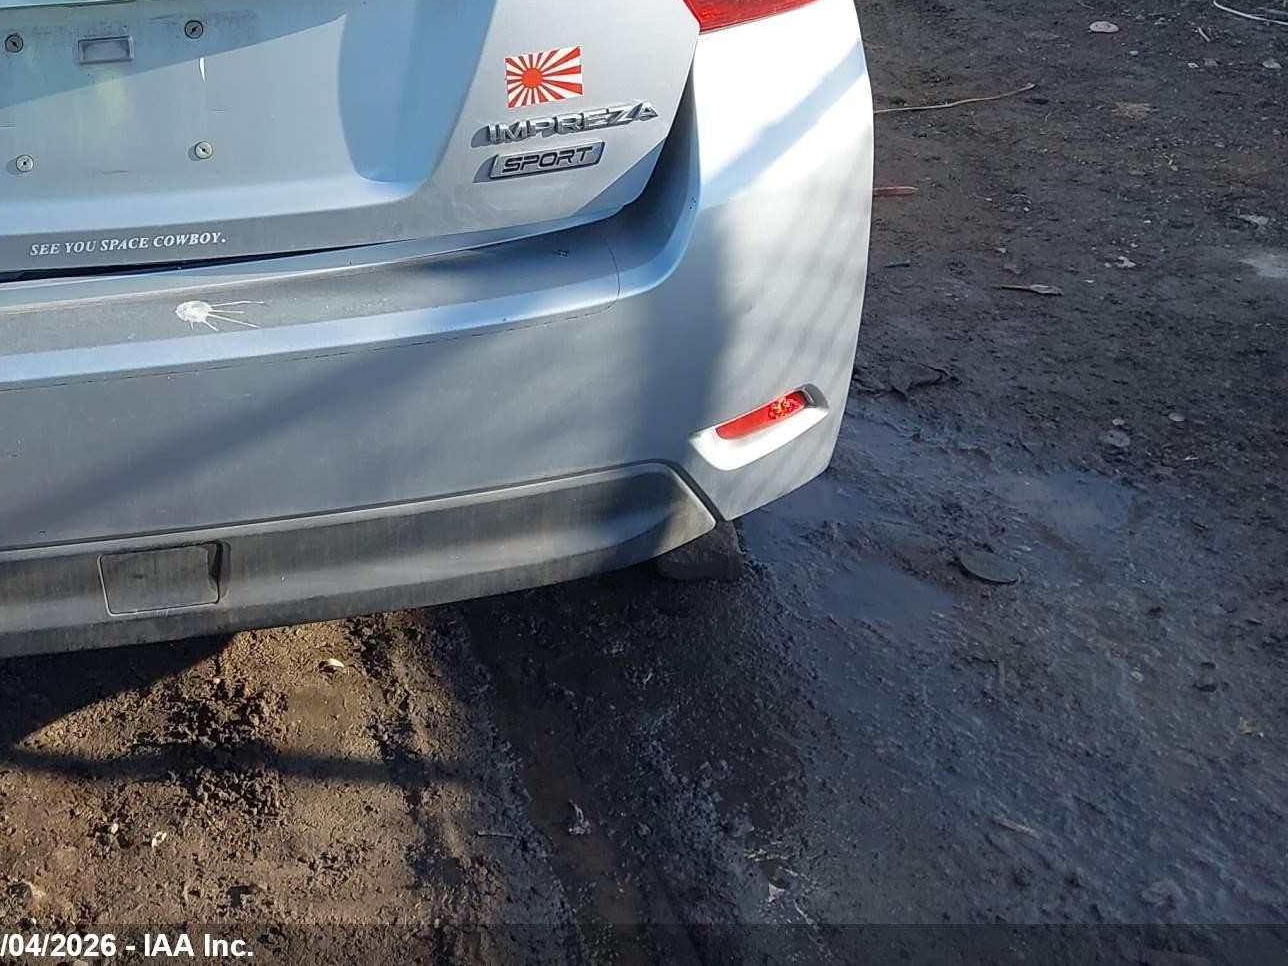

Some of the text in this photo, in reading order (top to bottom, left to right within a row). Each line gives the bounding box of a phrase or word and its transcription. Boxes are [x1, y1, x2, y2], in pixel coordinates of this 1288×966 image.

[487, 99, 659, 144] IMPREZA
[502, 146, 593, 173] SPORT
[30, 232, 226, 256] SEE YOU SPACE COWBOY.
